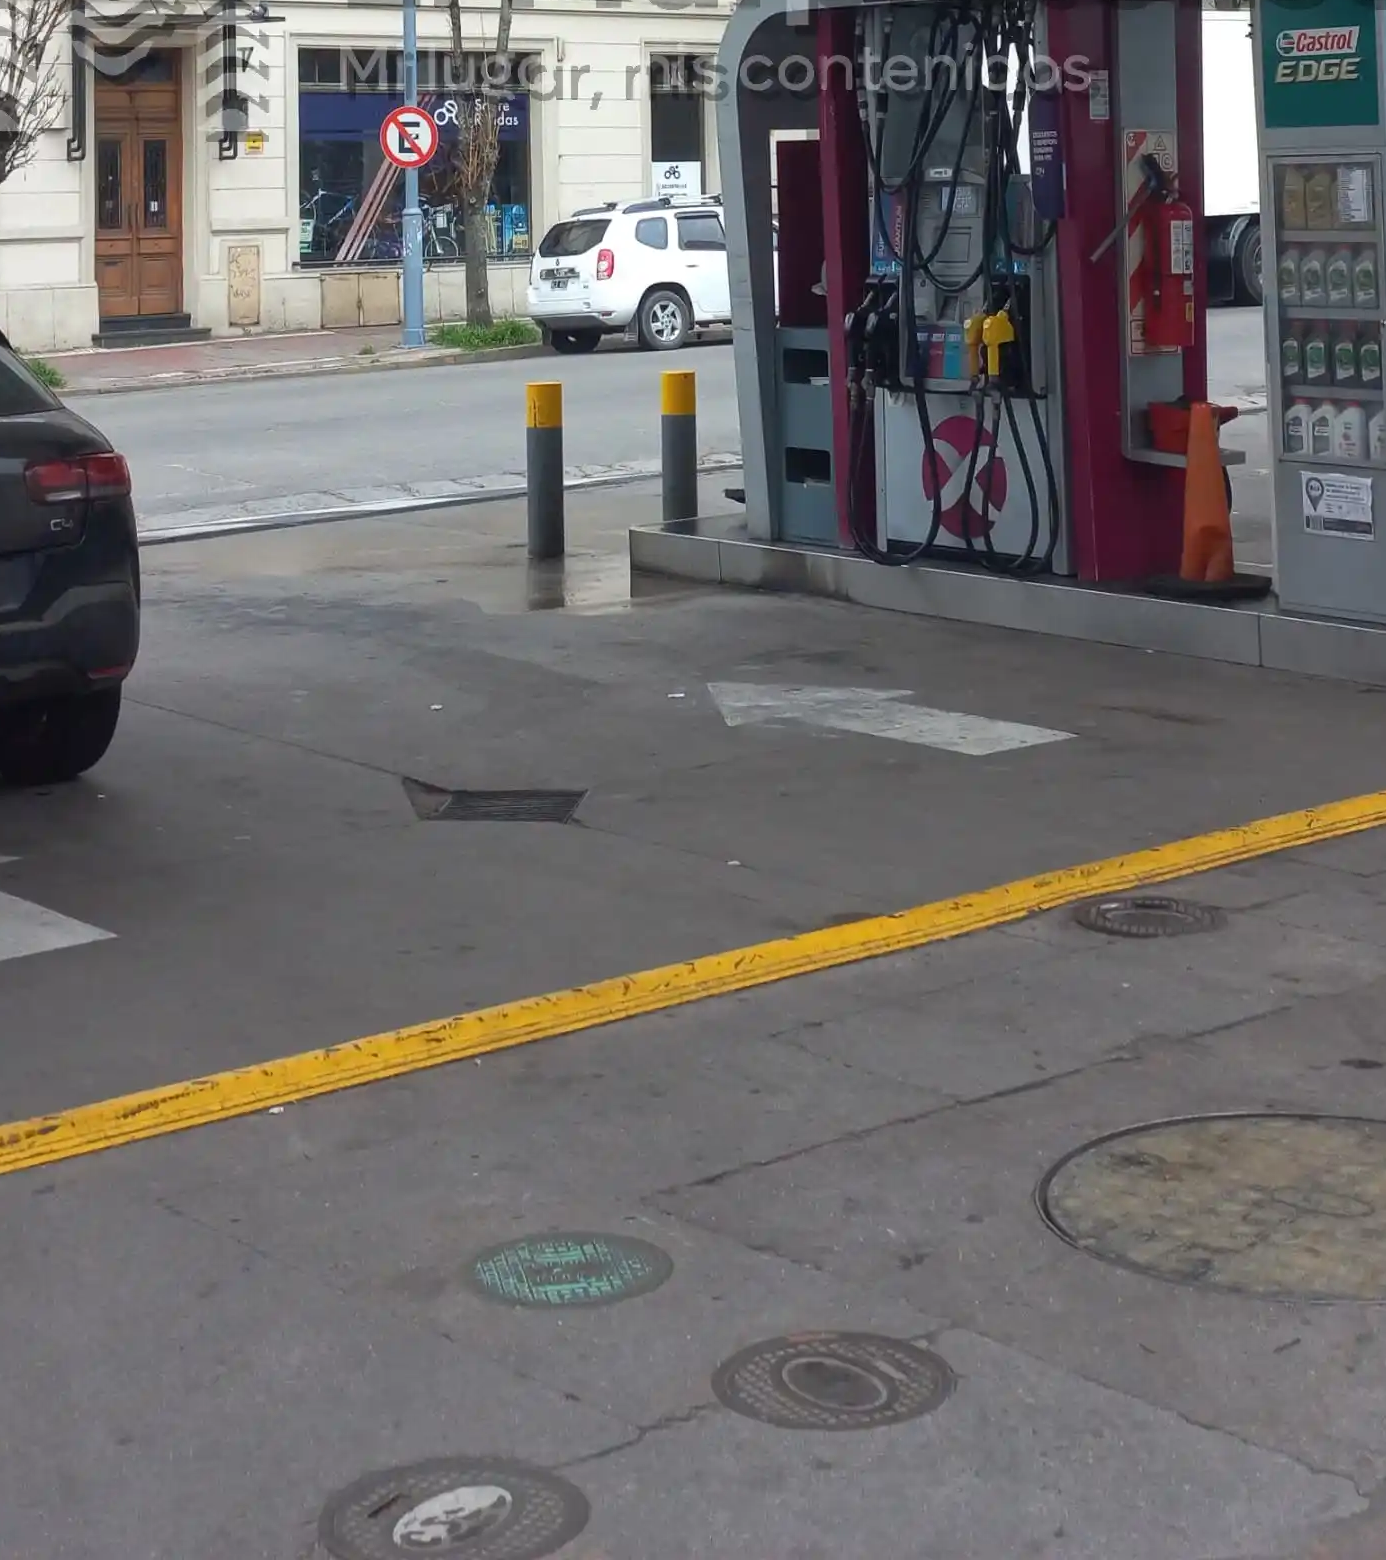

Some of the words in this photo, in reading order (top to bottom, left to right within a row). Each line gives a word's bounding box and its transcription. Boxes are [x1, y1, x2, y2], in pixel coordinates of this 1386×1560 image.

[1296, 29, 1354, 53] Castrol
[1275, 57, 1362, 84] EDGE
[50, 518, 74, 531] C4
